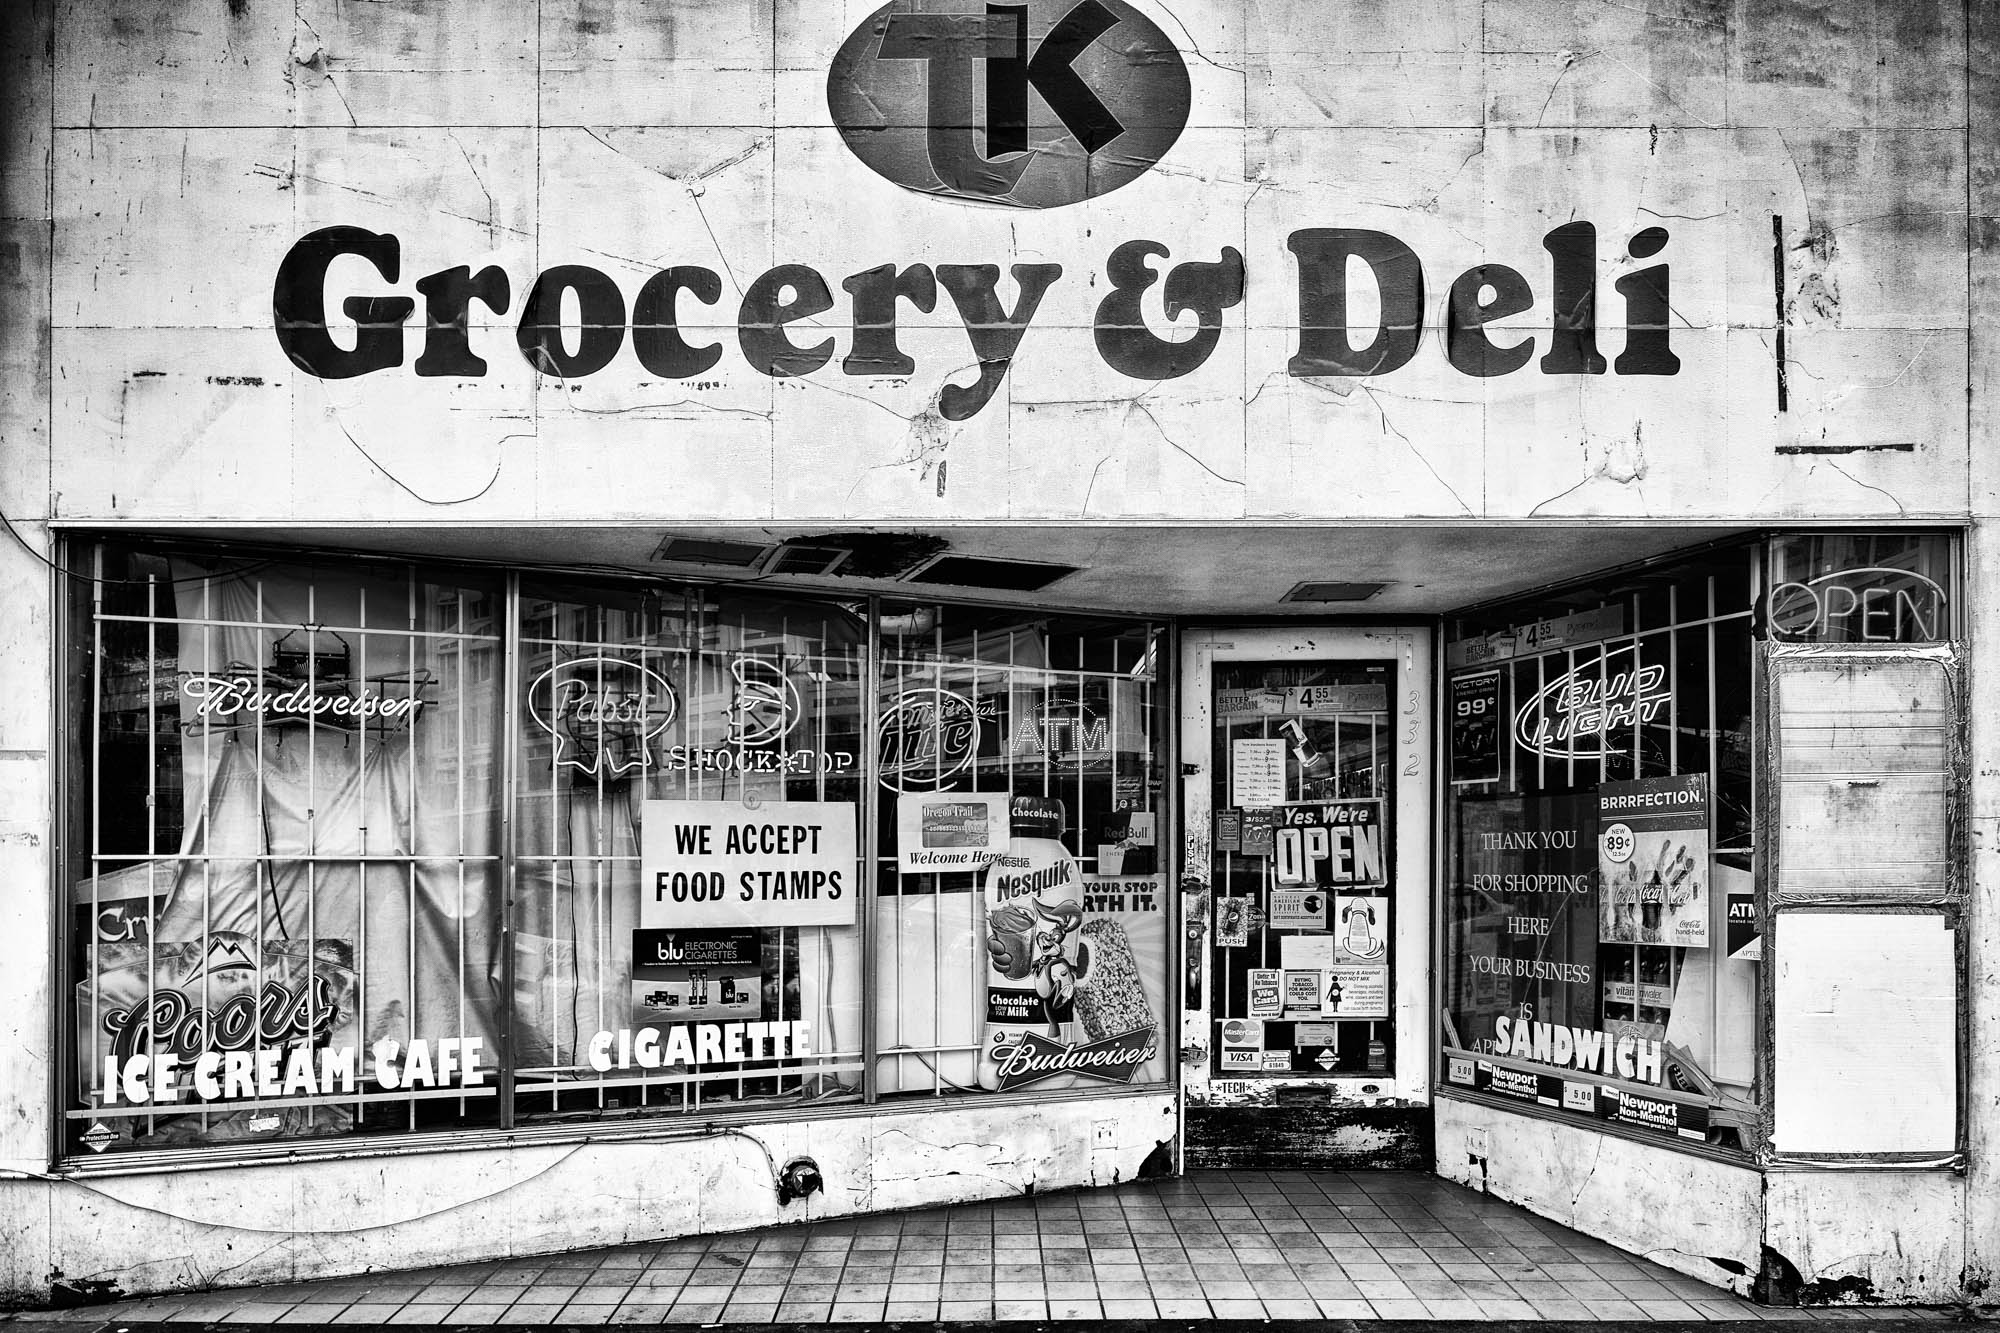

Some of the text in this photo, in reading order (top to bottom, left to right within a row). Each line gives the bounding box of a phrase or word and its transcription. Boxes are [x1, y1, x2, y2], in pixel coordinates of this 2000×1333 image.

[876, 0, 1127, 197] TK
[273, 220, 1681, 421] Grocery & Deli
[1769, 582, 1937, 641] OPEN
[1454, 676, 1497, 690] VICTORY
[1556, 664, 1665, 712] BUD
[183, 677, 422, 717] Budweiser
[555, 679, 657, 722] Pabst
[1218, 700, 1258, 713] BARGAIN
[1219, 696, 1249, 704] BETTER
[1532, 692, 1672, 746] LIGHT
[1011, 717, 1108, 751] ATM
[1601, 789, 1704, 810] BRRRFECTION.
[923, 805, 973, 818] Oregon Trail
[1012, 807, 1058, 819] Chocolate
[1322, 806, 1369, 823] We're
[674, 824, 822, 855] WE ACCEPT
[1104, 826, 1148, 838] Red Bull
[1480, 830, 1577, 850] THANK YOU
[1607, 836, 1631, 850] 89¢
[909, 850, 1002, 865] Welcome Here
[1276, 825, 1380, 885] OPEN
[655, 870, 842, 902] FOOD STAMPS
[996, 859, 1073, 903] Nesquik
[1082, 881, 1158, 893] YOUR STOP
[1473, 873, 1588, 893] FOR SHOPPING
[1081, 894, 1157, 912] RTH IT.
[1273, 903, 1300, 911] SPIRIT
[1506, 917, 1550, 936] HERE
[1675, 928, 1705, 936] hand-held
[657, 942, 684, 961] blu
[684, 941, 738, 951] ELECTRONIC
[684, 950, 738, 960] CIGARETTES
[1470, 954, 1591, 984] YOUR BUSINESS
[990, 994, 1039, 1006] Chocolate
[1007, 1006, 1029, 1017] Milk
[1519, 1001, 1533, 1020] IS
[103, 973, 338, 1081] Coors
[1224, 1028, 1260, 1036] MasterCard
[588, 1020, 812, 1072] CIGARETTE
[1495, 1015, 1663, 1084] SANDWICH
[991, 1041, 1155, 1077] Budweiser
[1230, 1052, 1253, 1062] VISA
[103, 1053, 179, 1104] ICE
[194, 1046, 355, 1100] CREAM
[373, 1036, 484, 1090] CAFE
[1492, 1064, 1538, 1086] Newport
[1491, 1077, 1538, 1095] Non-Menthol
[1620, 1092, 1678, 1117] Newport
[1619, 1105, 1677, 1127] Non-Menthol
